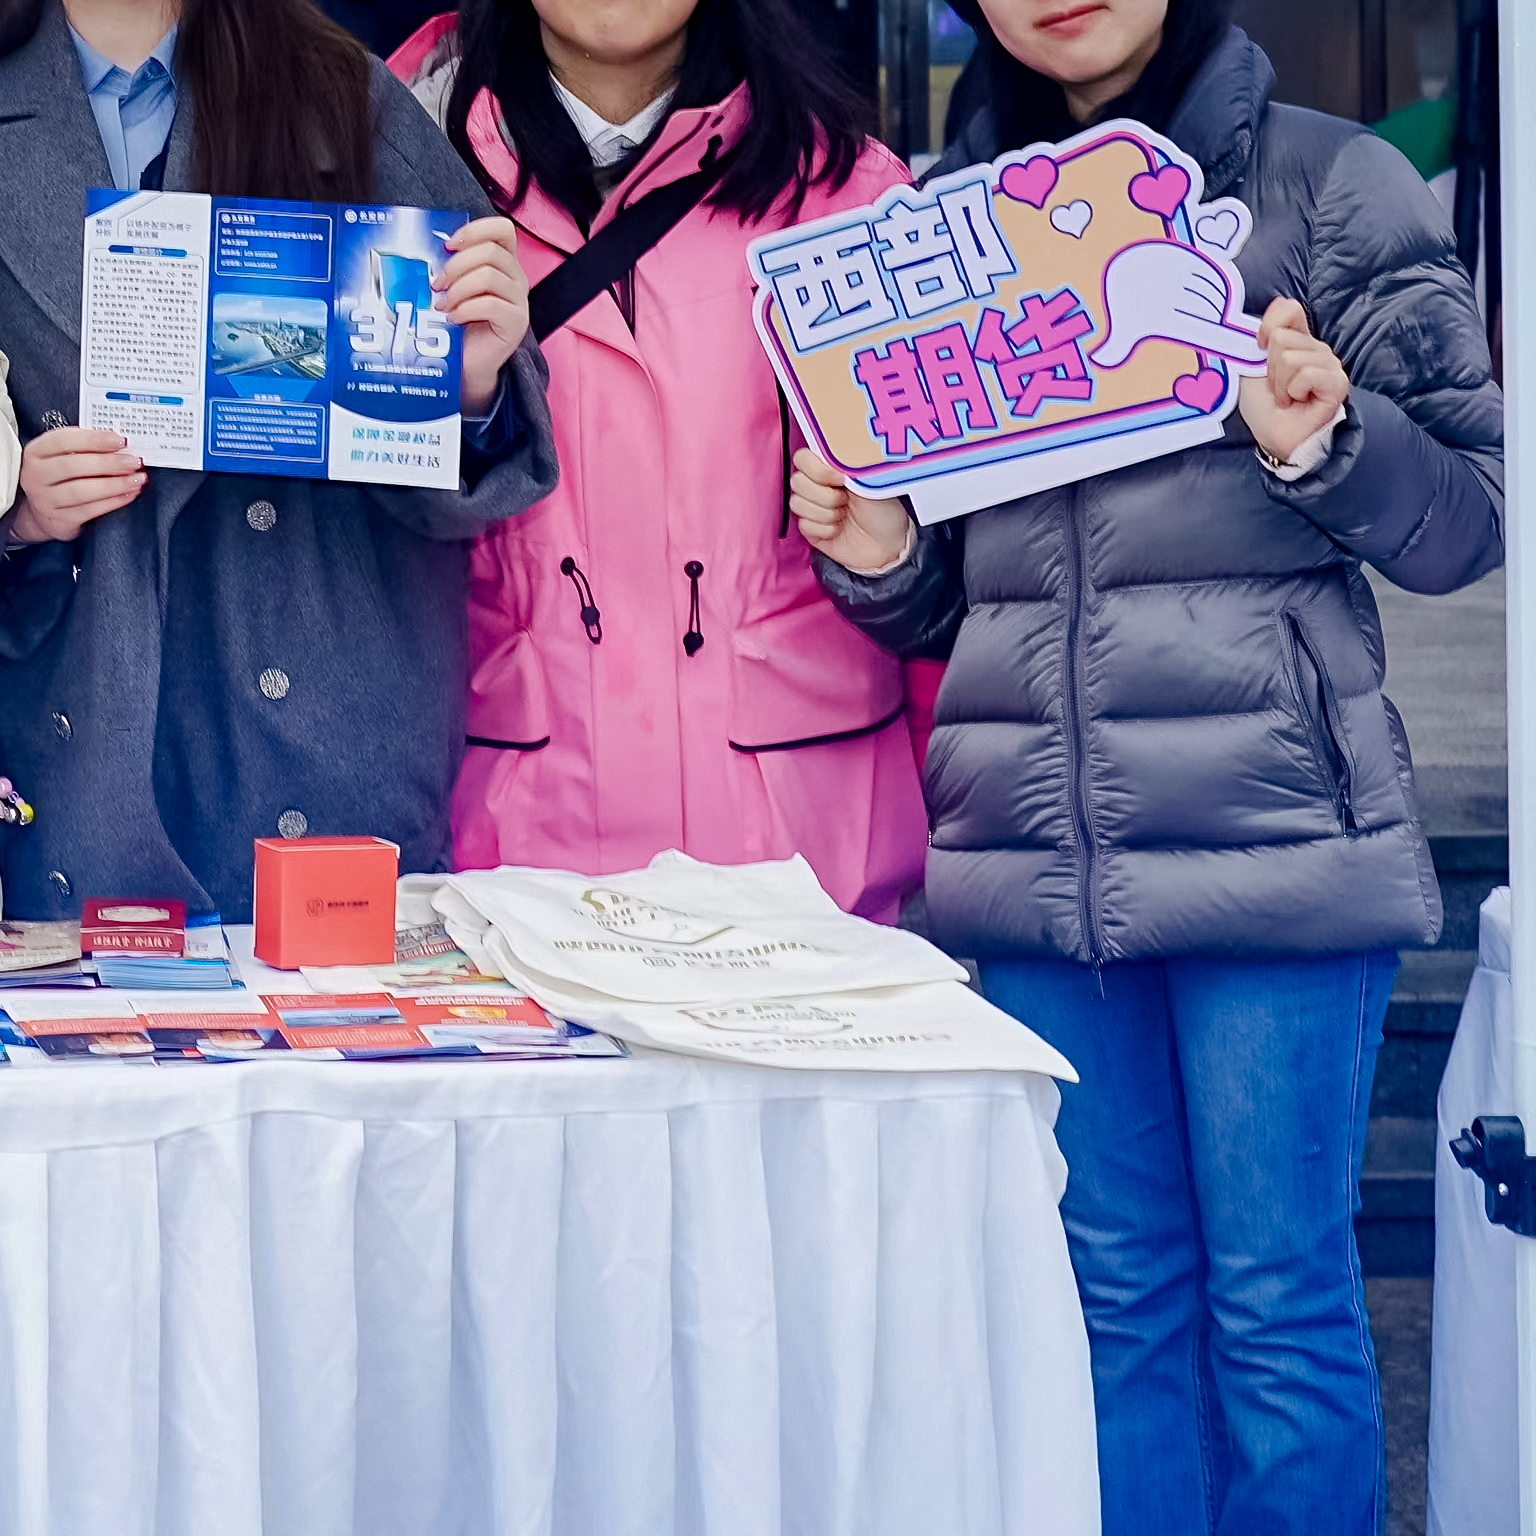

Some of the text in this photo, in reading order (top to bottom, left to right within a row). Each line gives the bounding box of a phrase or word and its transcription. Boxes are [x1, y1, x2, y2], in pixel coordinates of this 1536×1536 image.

[350, 300, 452, 360] 315
[760, 180, 1018, 354] 西部
[854, 288, 1095, 456] 期货
